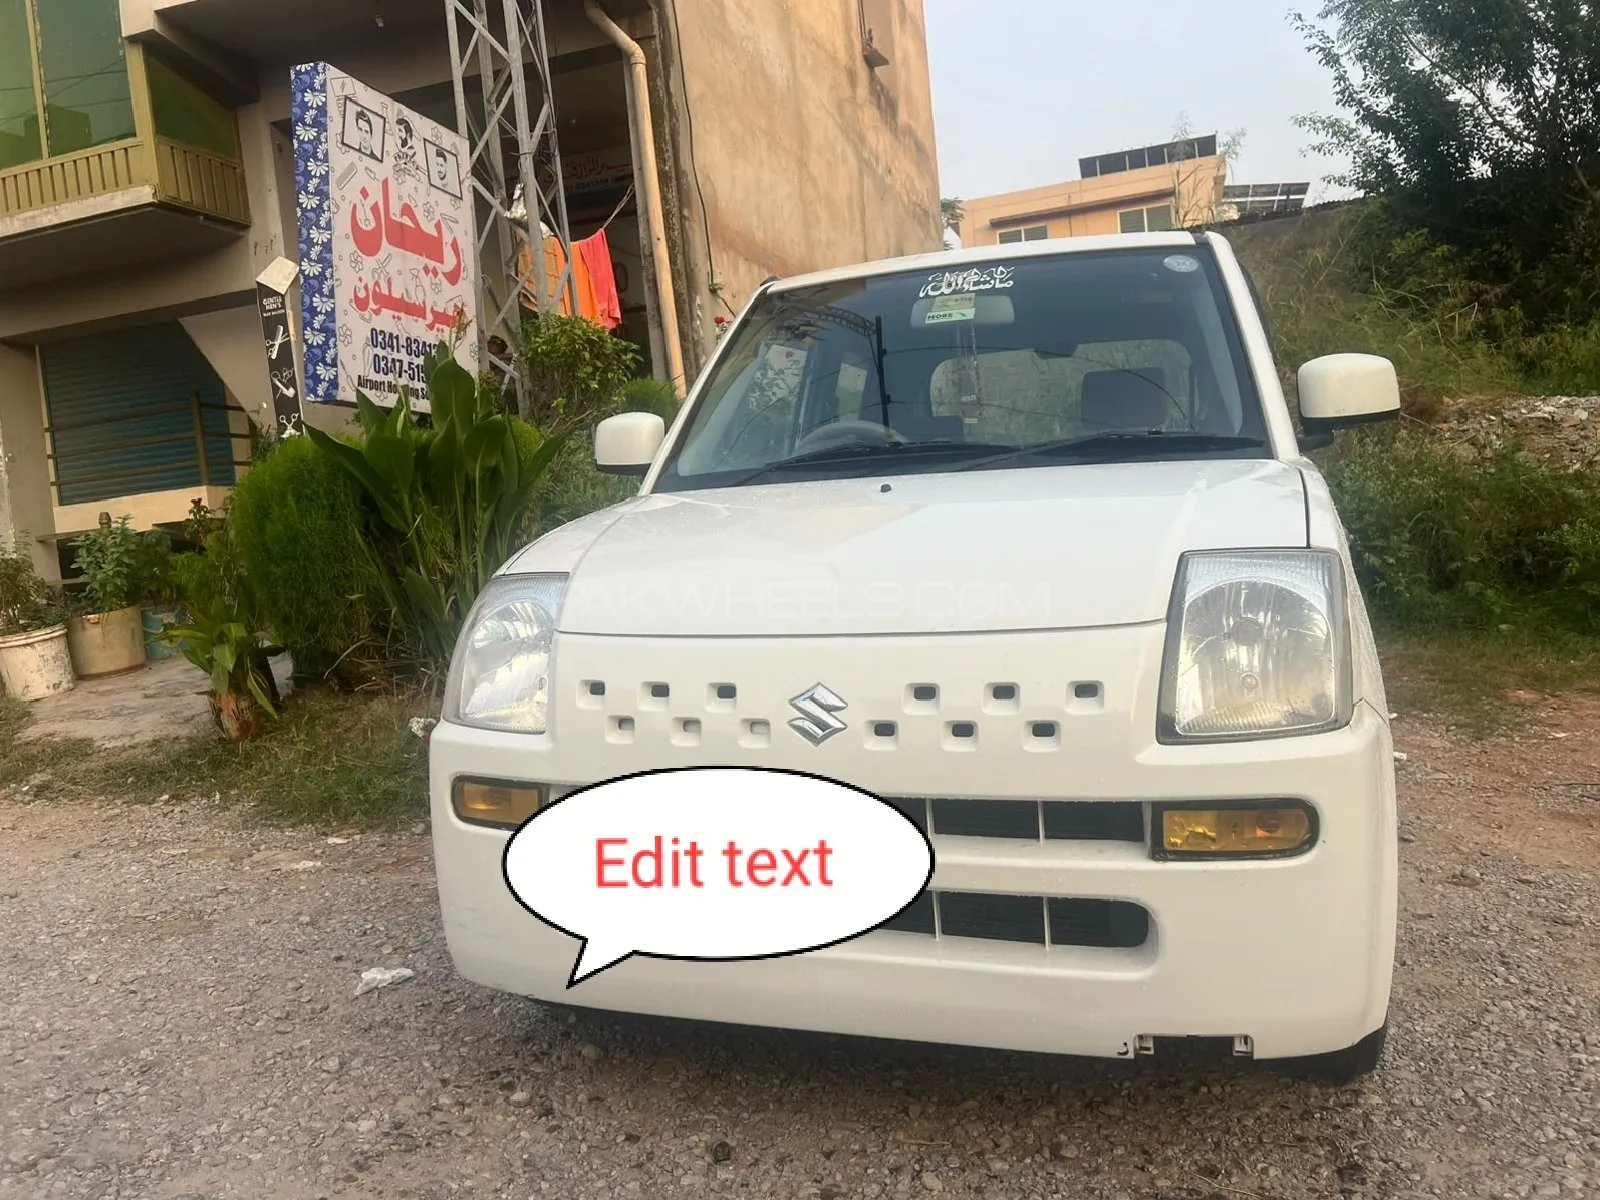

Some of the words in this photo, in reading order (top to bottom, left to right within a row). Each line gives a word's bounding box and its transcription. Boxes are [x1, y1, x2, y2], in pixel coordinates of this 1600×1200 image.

[351, 177, 462, 286] ریحان
[353, 276, 427, 321] سیلون
[357, 374, 386, 393] Airport
[387, 380, 420, 400] Hong
